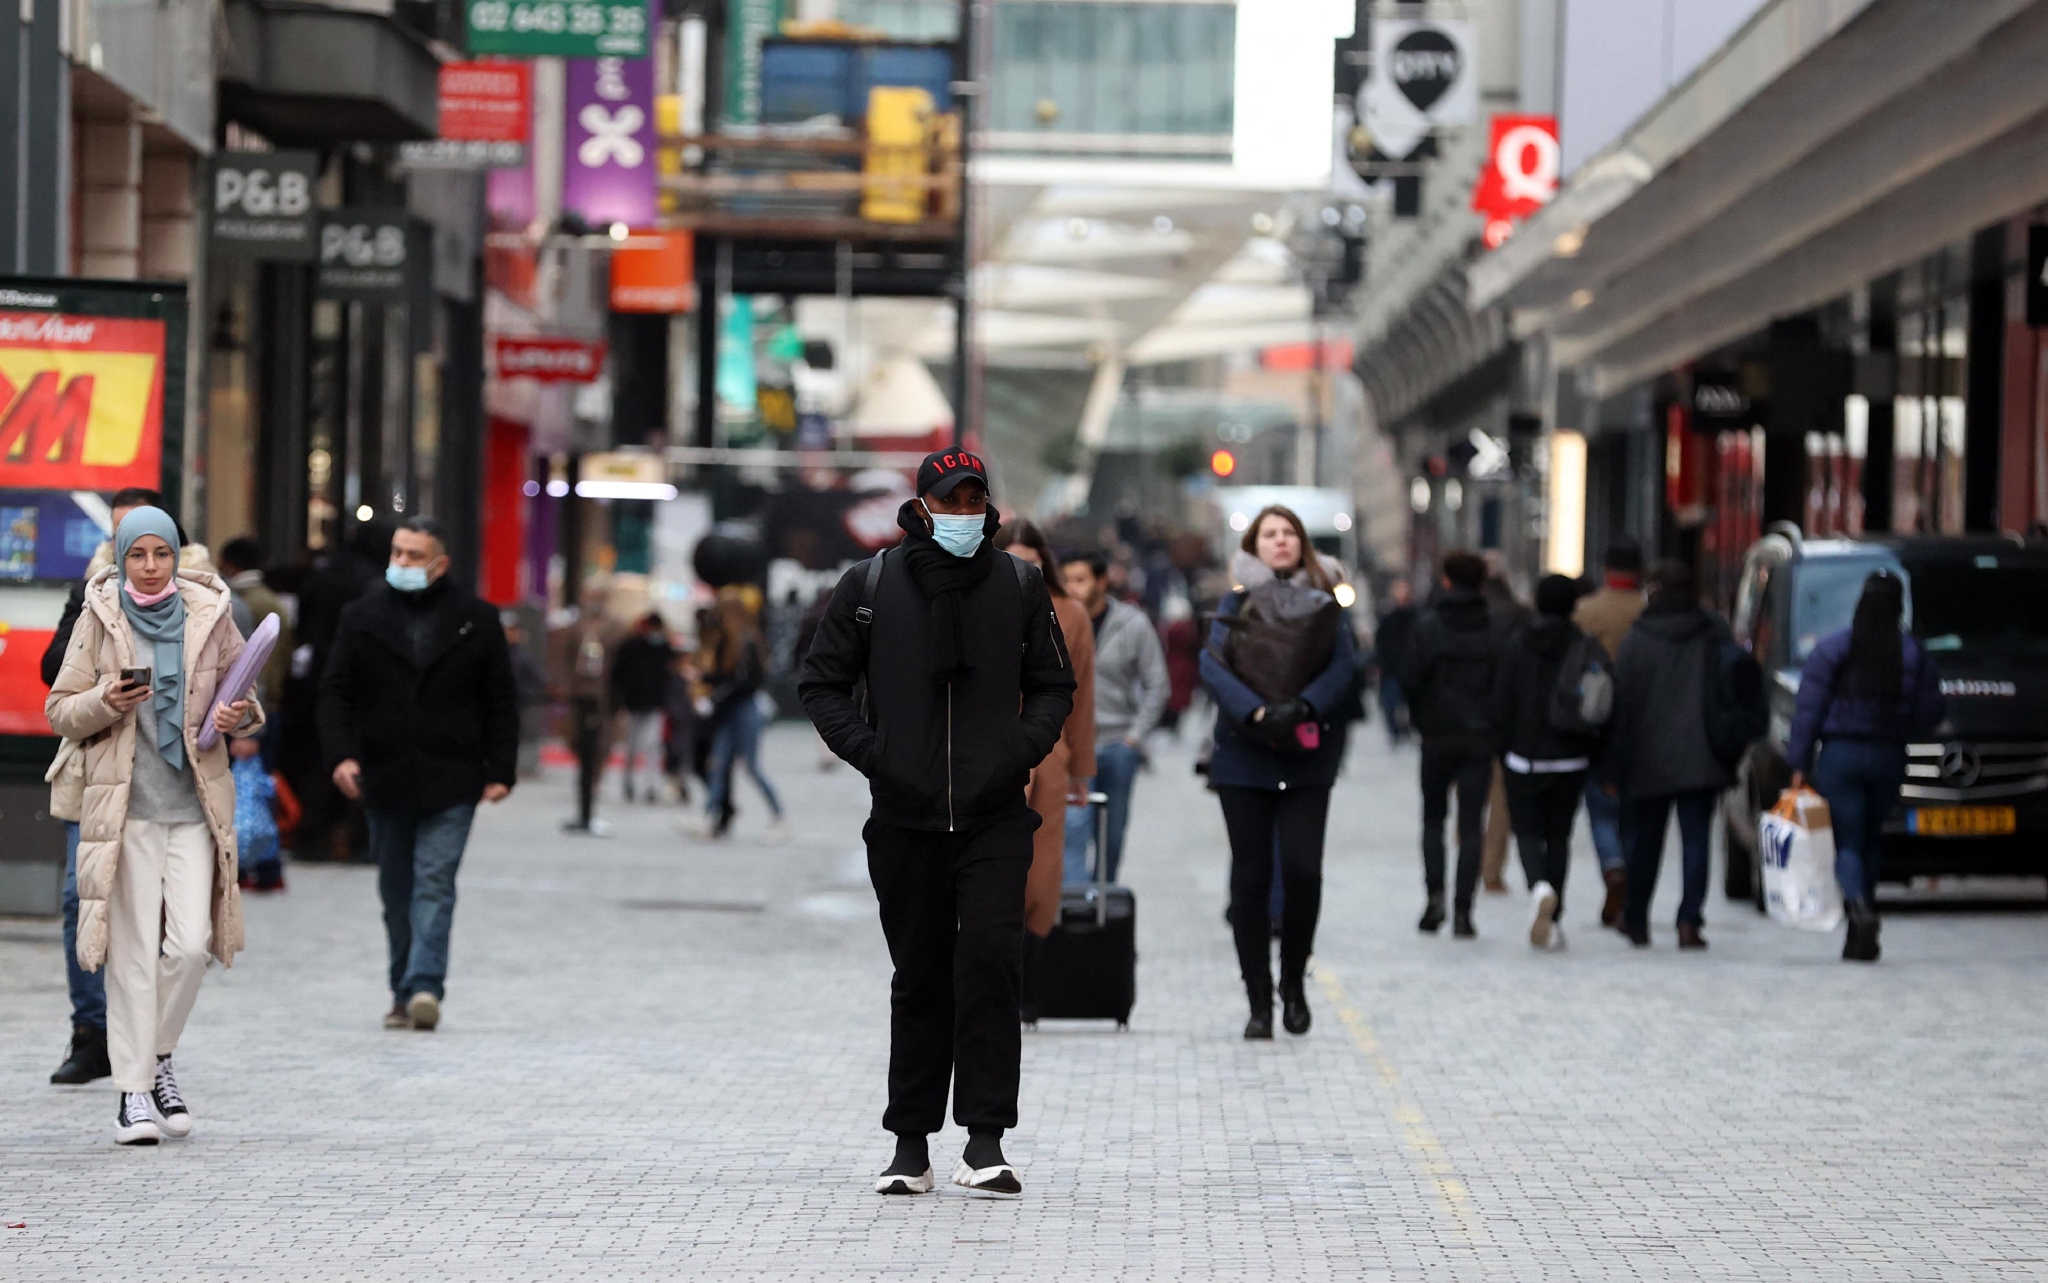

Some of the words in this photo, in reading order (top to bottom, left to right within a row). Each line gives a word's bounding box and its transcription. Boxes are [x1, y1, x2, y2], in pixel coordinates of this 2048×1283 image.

[215, 168, 311, 216] P&B
[320, 224, 406, 267] P&B
[932, 452, 983, 475] ICON
